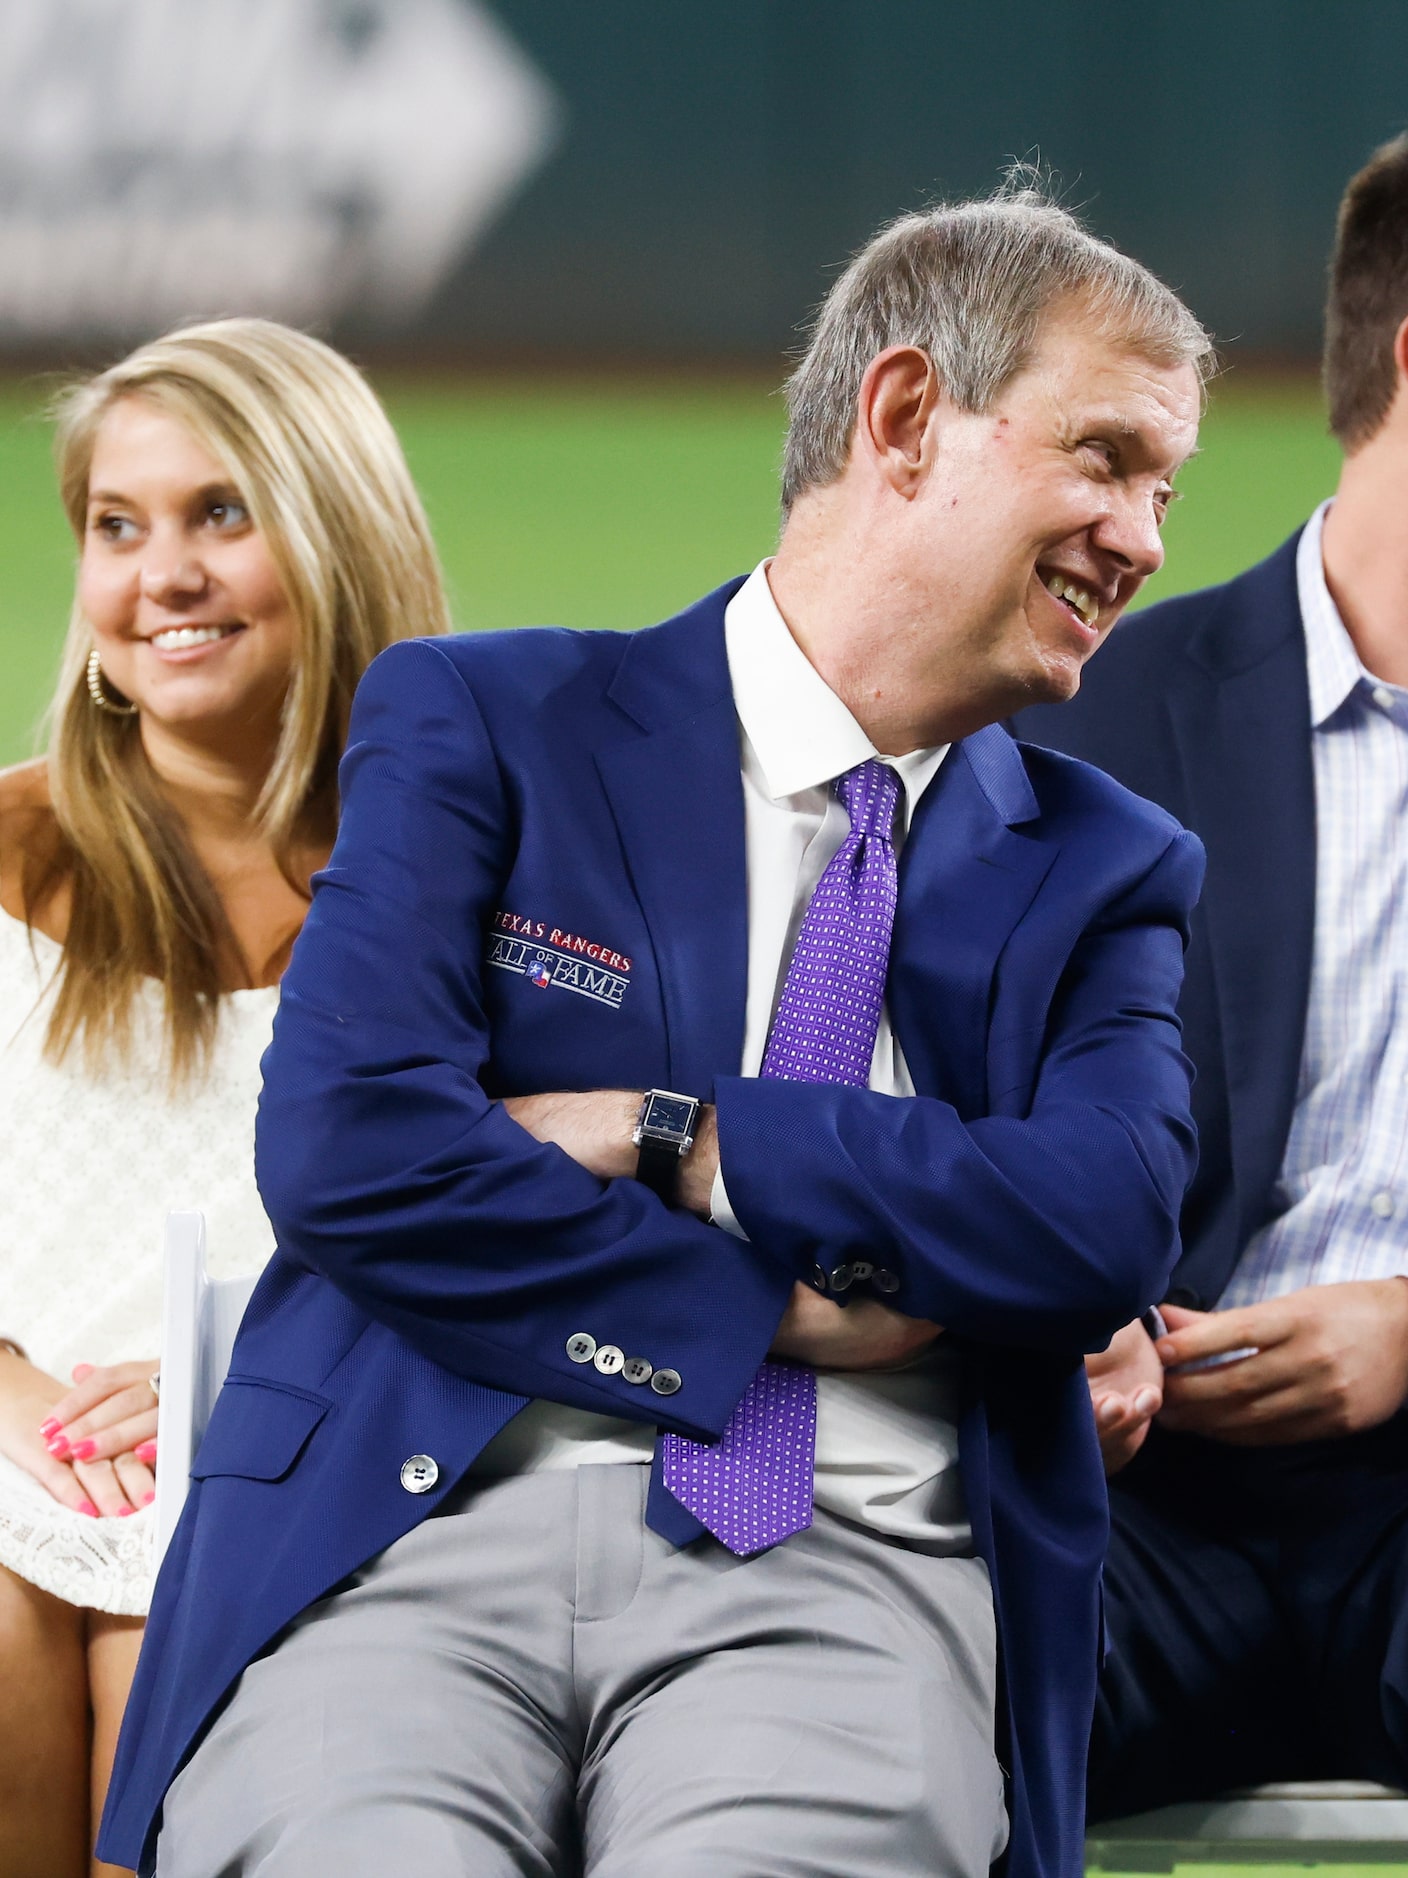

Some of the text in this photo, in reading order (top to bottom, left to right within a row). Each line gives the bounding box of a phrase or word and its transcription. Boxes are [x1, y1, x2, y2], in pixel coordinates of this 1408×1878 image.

[490, 938, 629, 1003] ALL OF FAME
[494, 911, 633, 973] TEXAS RANGERS
